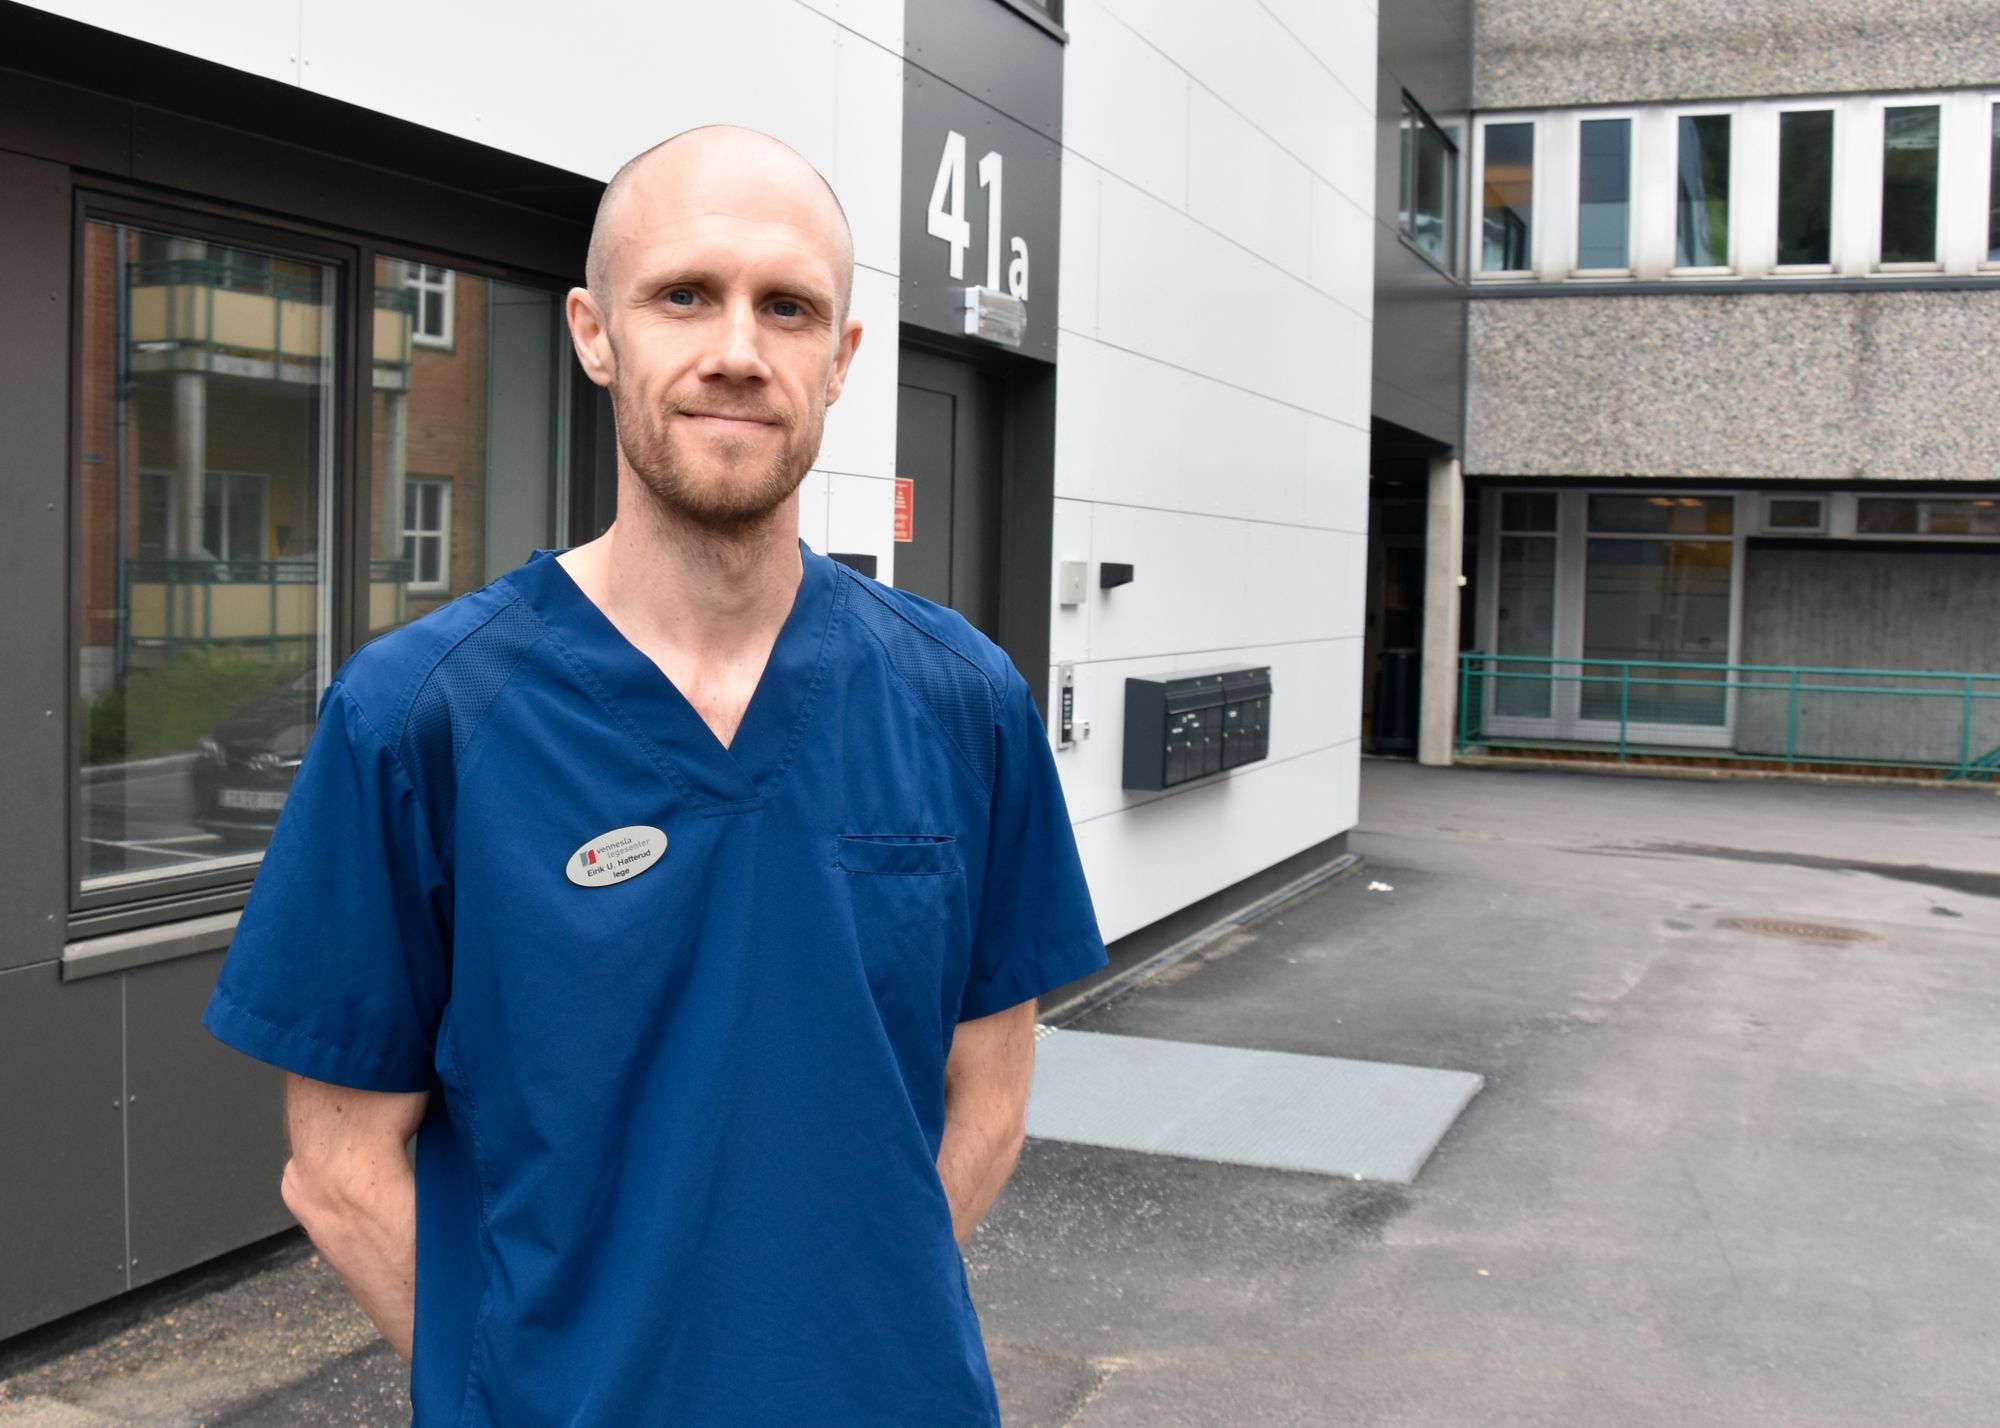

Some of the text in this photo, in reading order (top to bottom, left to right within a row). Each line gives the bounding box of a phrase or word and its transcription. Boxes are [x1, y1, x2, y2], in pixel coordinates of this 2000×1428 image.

[927, 129, 1030, 302] 41a
[596, 837, 632, 854] vennesla
[607, 839, 650, 859] legesenter
[587, 849, 651, 877] Eirik U. Hatterud
[613, 867, 630, 879] lege
